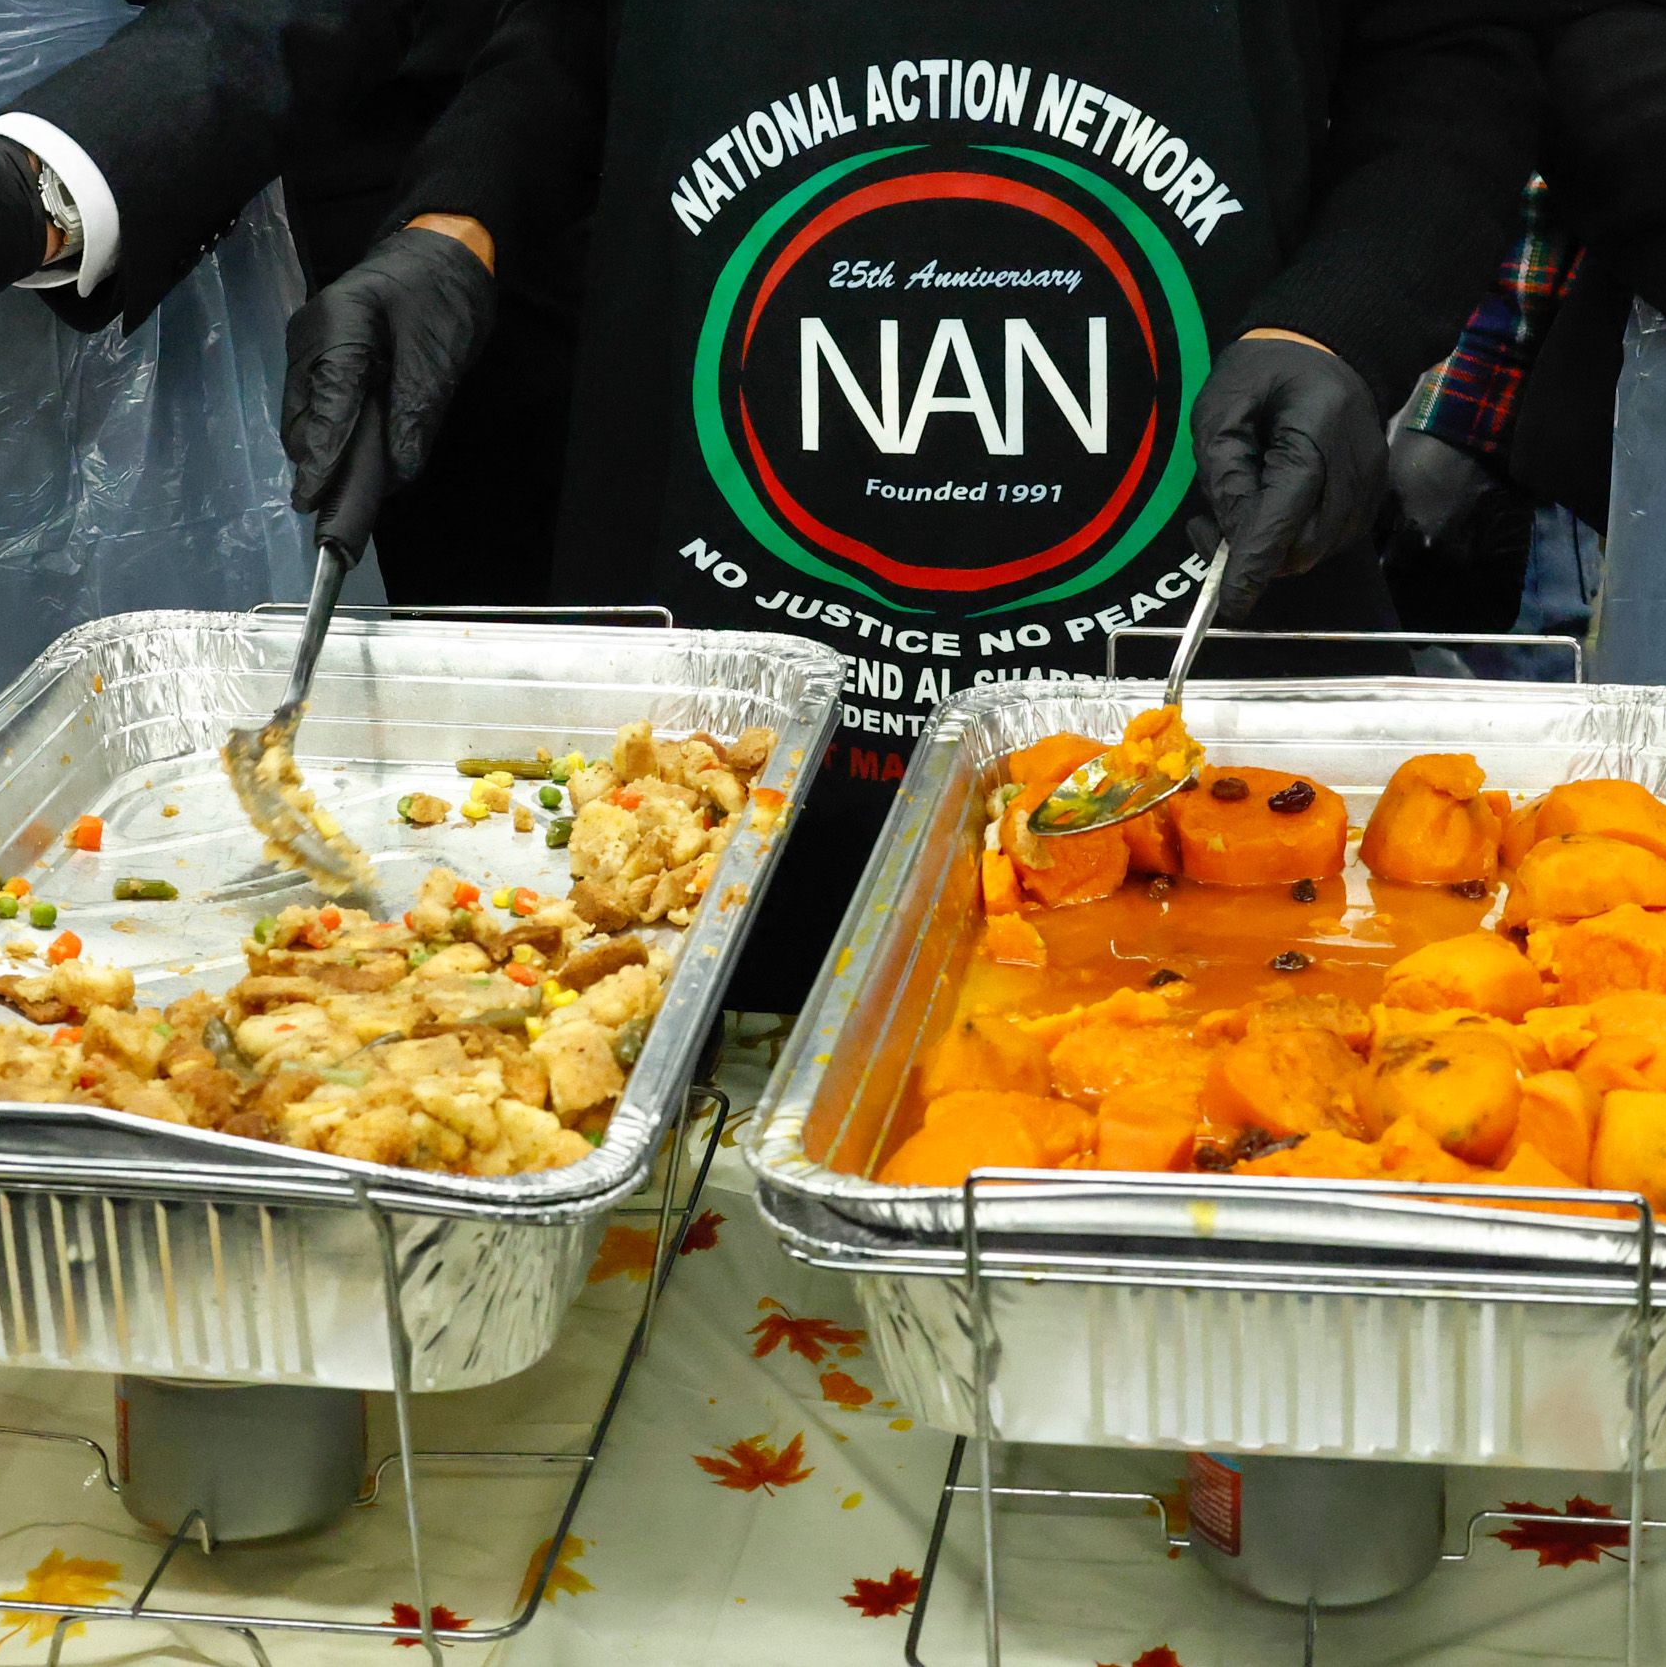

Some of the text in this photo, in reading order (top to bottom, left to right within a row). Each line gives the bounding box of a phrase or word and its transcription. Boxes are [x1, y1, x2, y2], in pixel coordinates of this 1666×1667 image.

[669, 58, 1244, 246] NATIONAL ACTION NETWORK
[828, 260, 1084, 294] 25th Anniversary
[800, 316, 1109, 456] NAN
[864, 477, 1063, 504] Founded 1991
[678, 536, 1214, 659] NO JUSTICE NO PEACE
[844, 655, 904, 702] END
